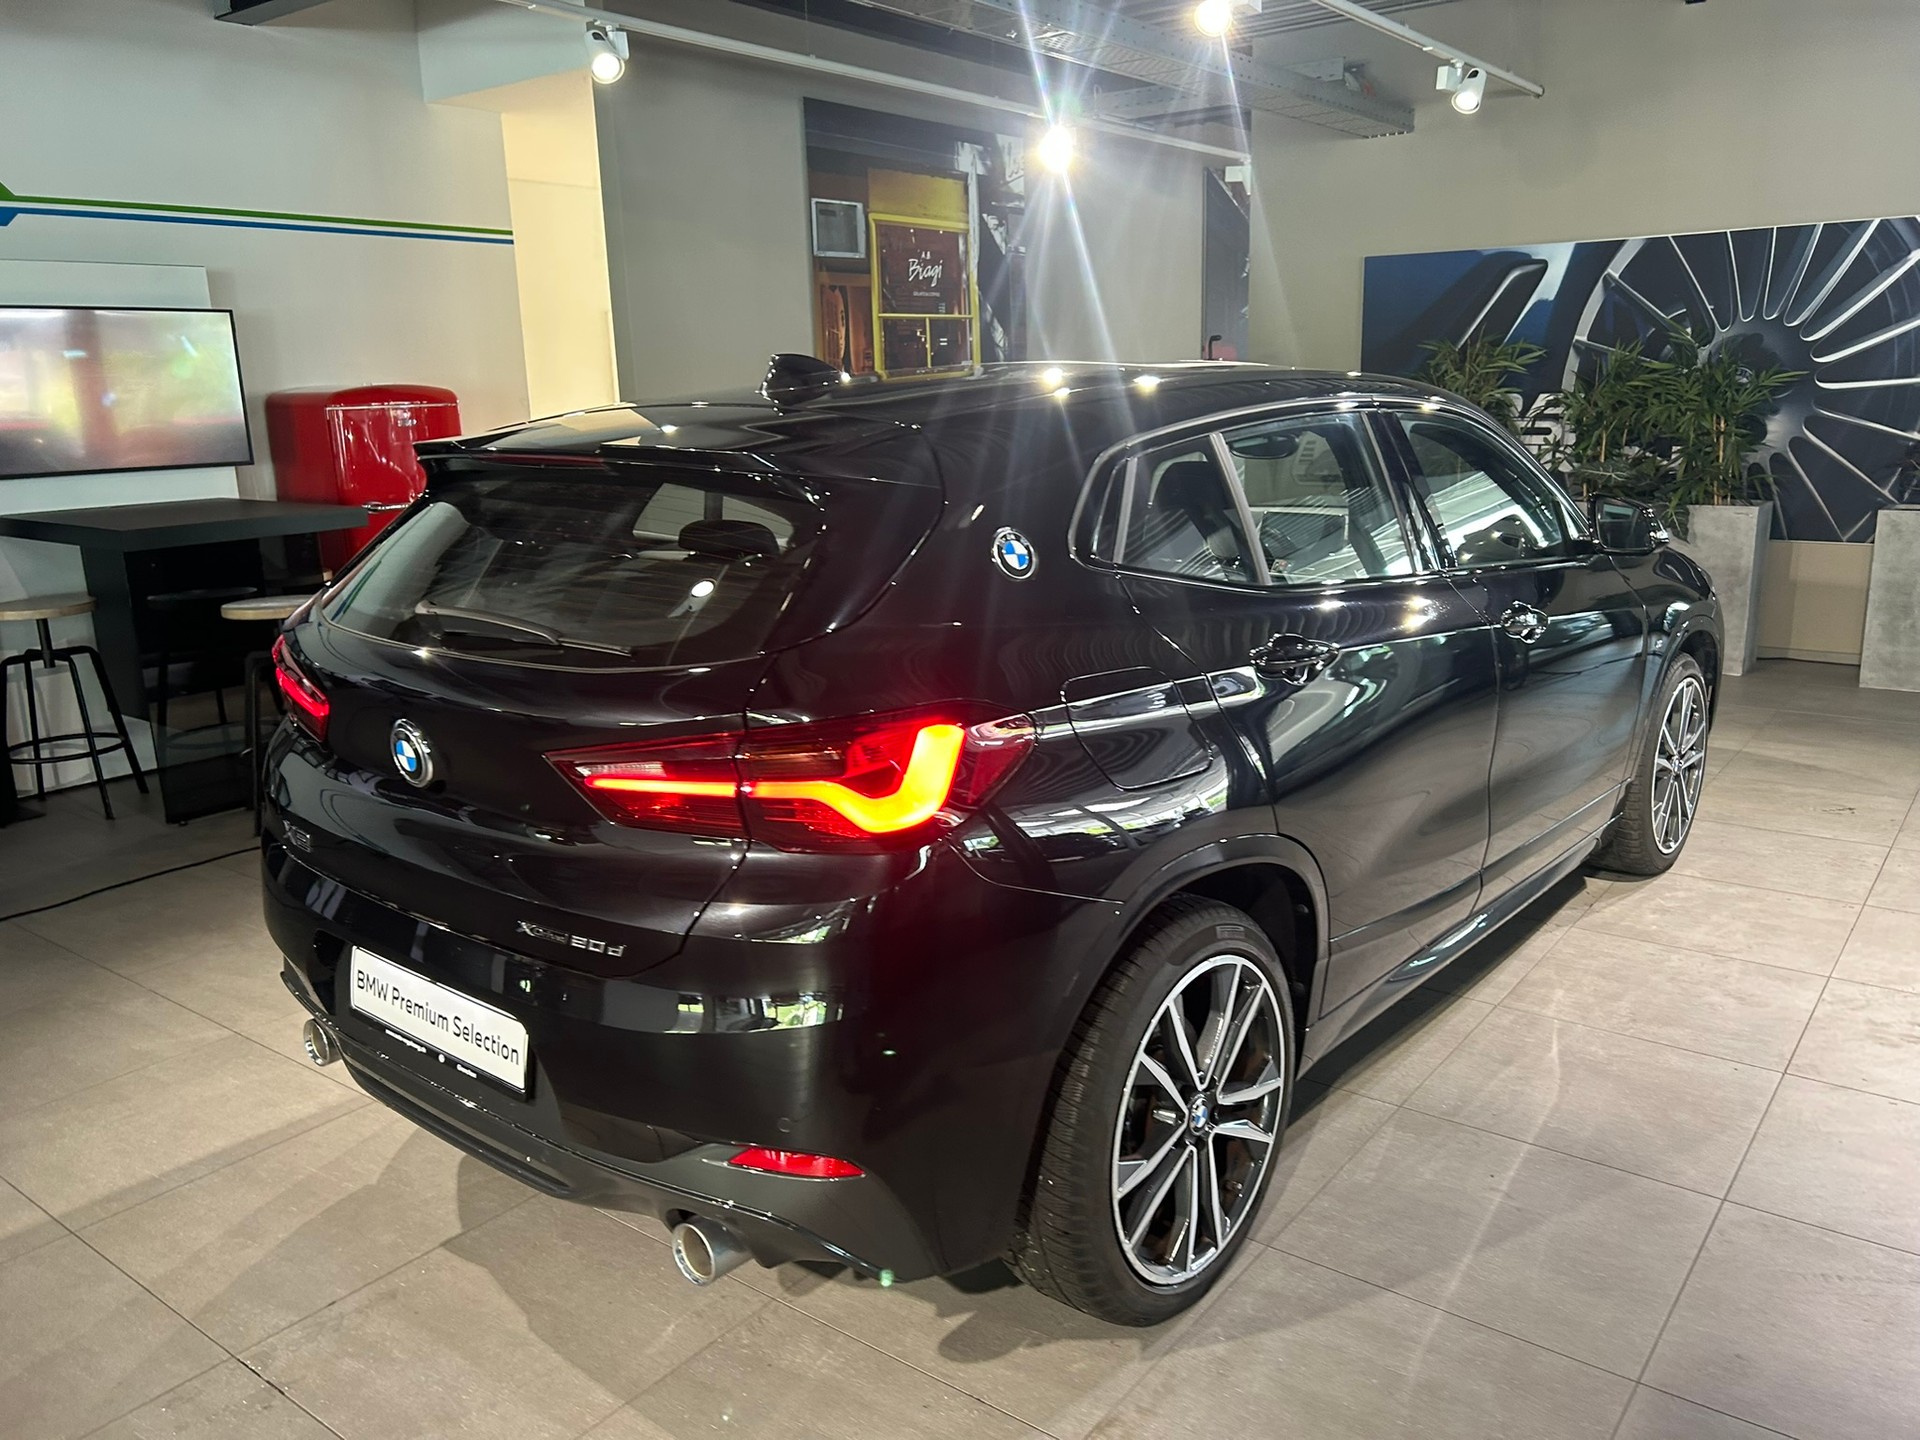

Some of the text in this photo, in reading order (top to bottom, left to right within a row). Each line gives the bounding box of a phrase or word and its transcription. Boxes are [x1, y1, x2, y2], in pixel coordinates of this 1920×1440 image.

[908, 258, 943, 287] Biagi
[357, 969, 389, 1001] BMW
[392, 987, 449, 1033] Premium
[453, 1016, 519, 1065] Selection
